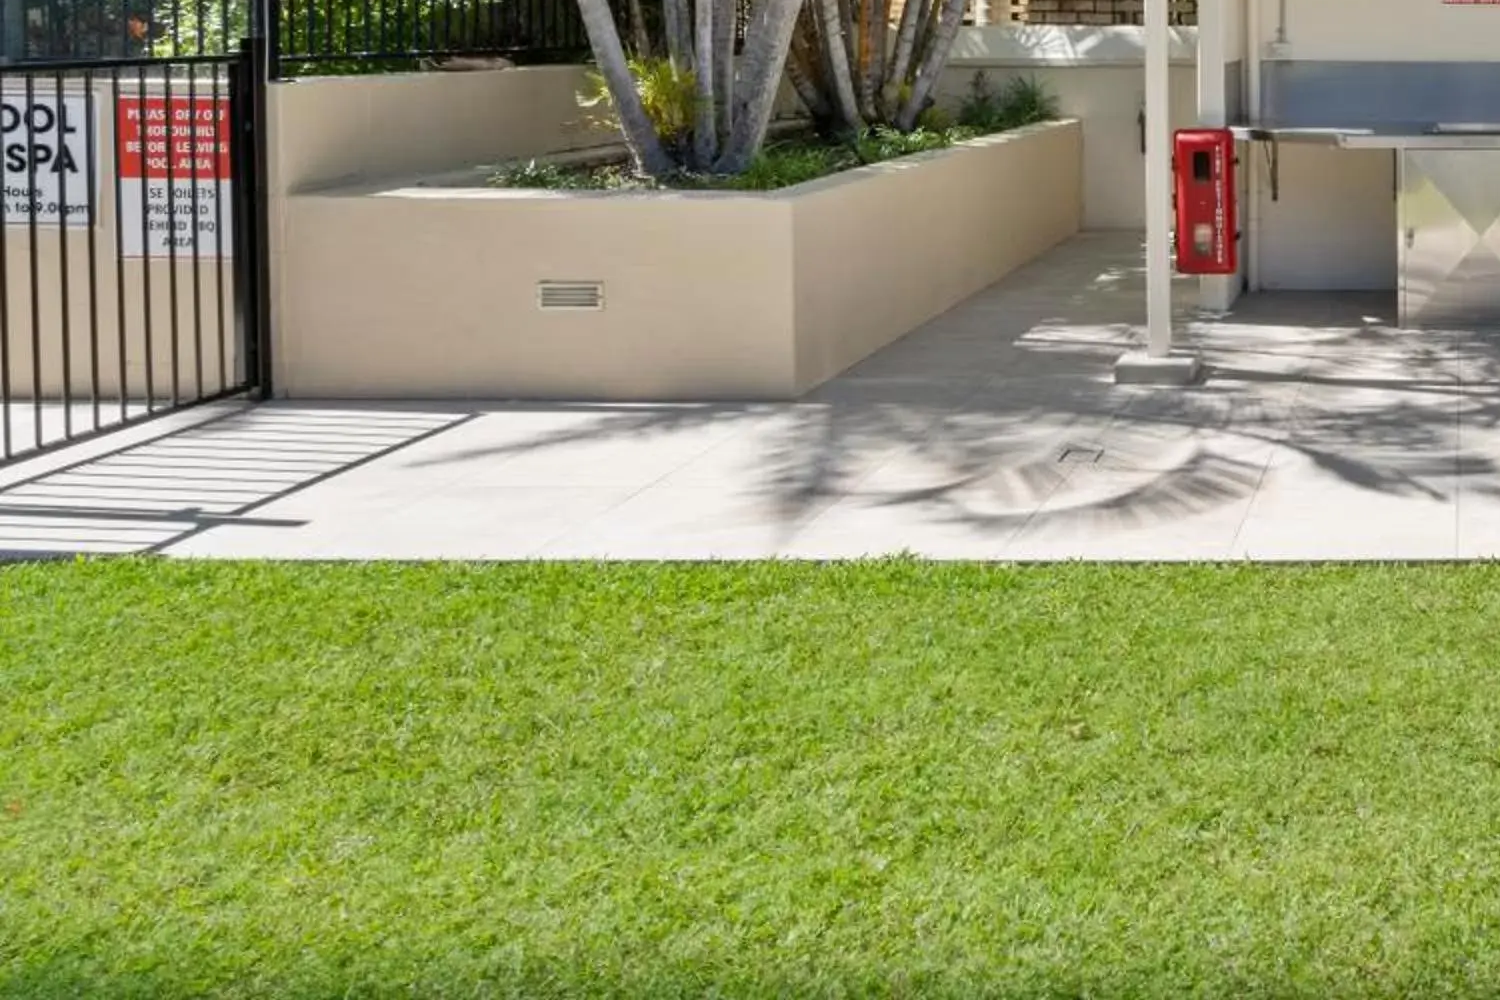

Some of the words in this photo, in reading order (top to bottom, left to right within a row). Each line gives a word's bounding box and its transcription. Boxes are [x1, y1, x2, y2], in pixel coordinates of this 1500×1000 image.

[0, 103, 76, 133] OOL
[203, 109, 225, 120] OF
[6, 143, 78, 173] SPA
[147, 187, 163, 199] SE
[147, 204, 208, 215] PROVIDD
[195, 220, 215, 232] BQ
